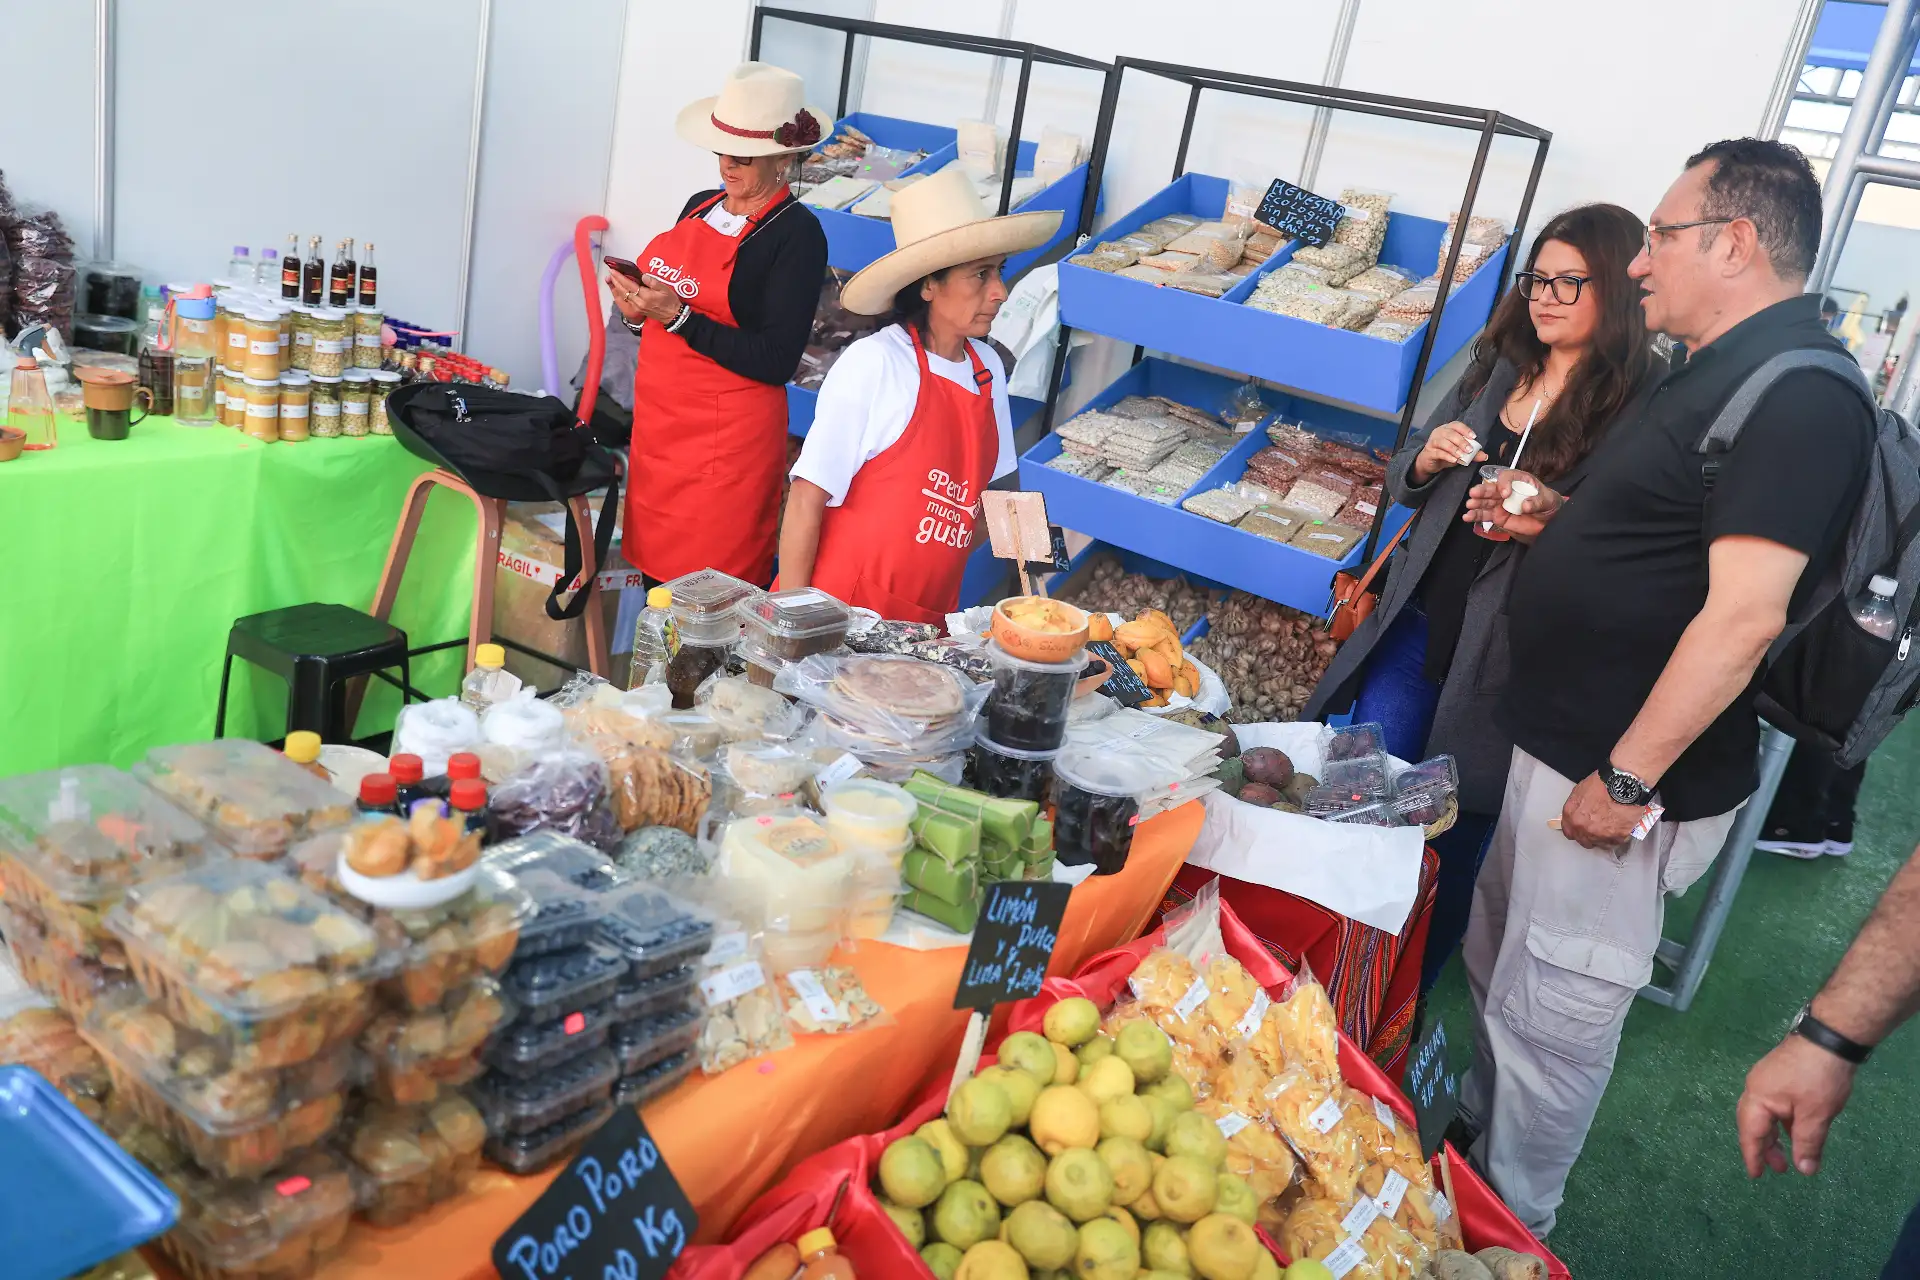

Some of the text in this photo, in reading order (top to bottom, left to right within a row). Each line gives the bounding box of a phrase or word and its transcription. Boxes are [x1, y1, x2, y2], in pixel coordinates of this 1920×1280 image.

[1261, 203, 1281, 217] sin
[648, 256, 684, 282] Perú
[927, 468, 969, 503] Perú
[915, 516, 973, 549] gusto
[497, 552, 532, 577] RÁGIL
[633, 1205, 686, 1258] Kg
